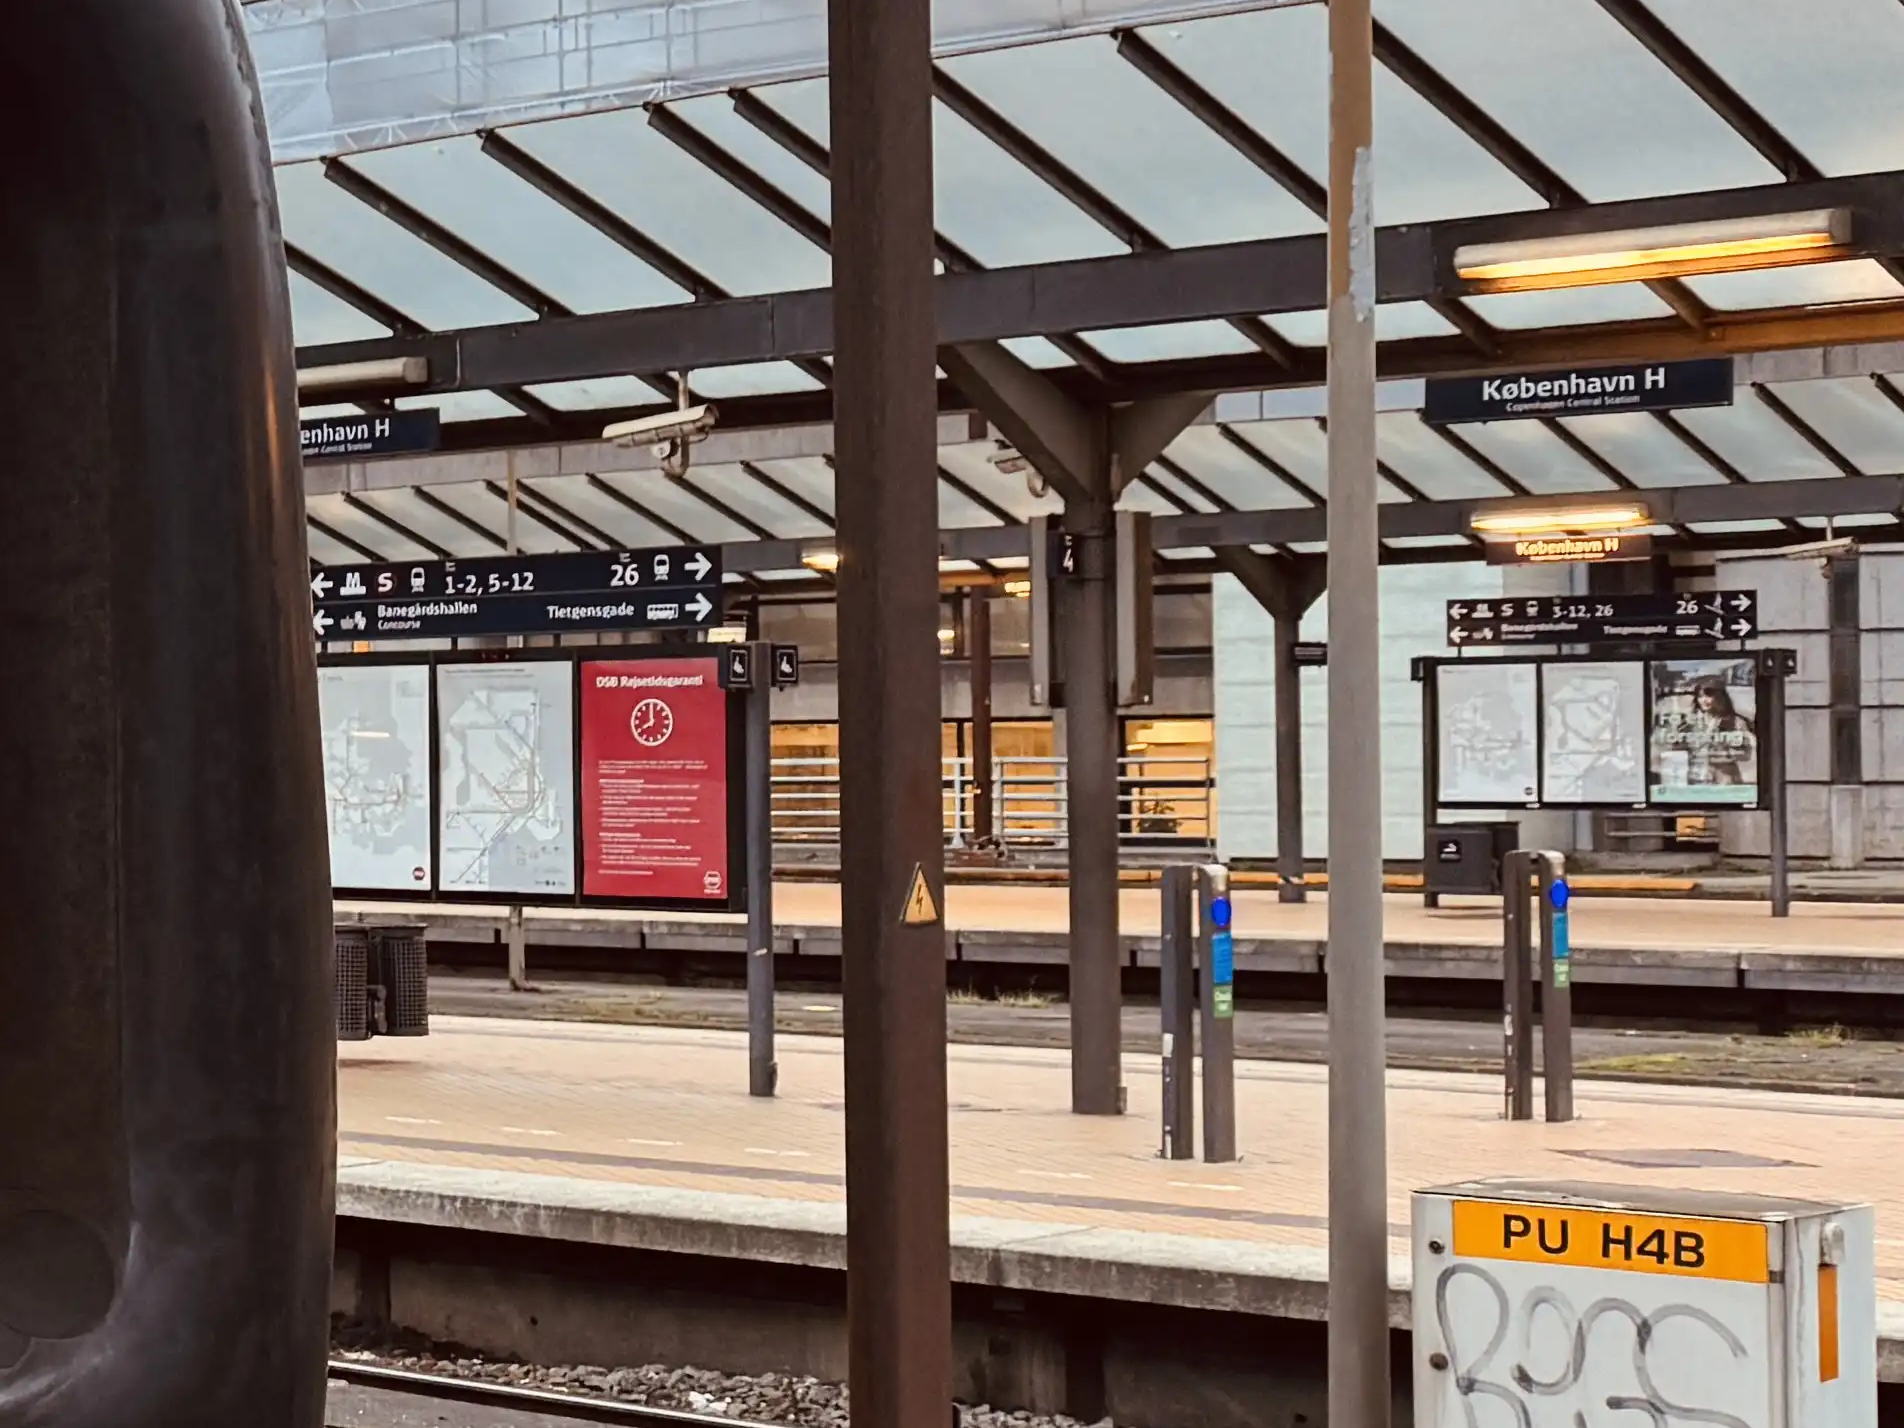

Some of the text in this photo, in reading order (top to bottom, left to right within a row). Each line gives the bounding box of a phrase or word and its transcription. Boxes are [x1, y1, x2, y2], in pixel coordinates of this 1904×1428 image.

[1483, 367, 1666, 401] København H
[300, 418, 390, 444] enhavn H
[445, 575, 483, 596] 1-2,
[488, 572, 534, 593] 5-12
[610, 564, 640, 587] 26
[377, 601, 478, 618] Banegårdshallen
[546, 601, 635, 620] Tietgensgade
[1595, 604, 1614, 617] 26
[1676, 600, 1699, 615] 26
[1503, 1214, 1705, 1268] PU H4B
